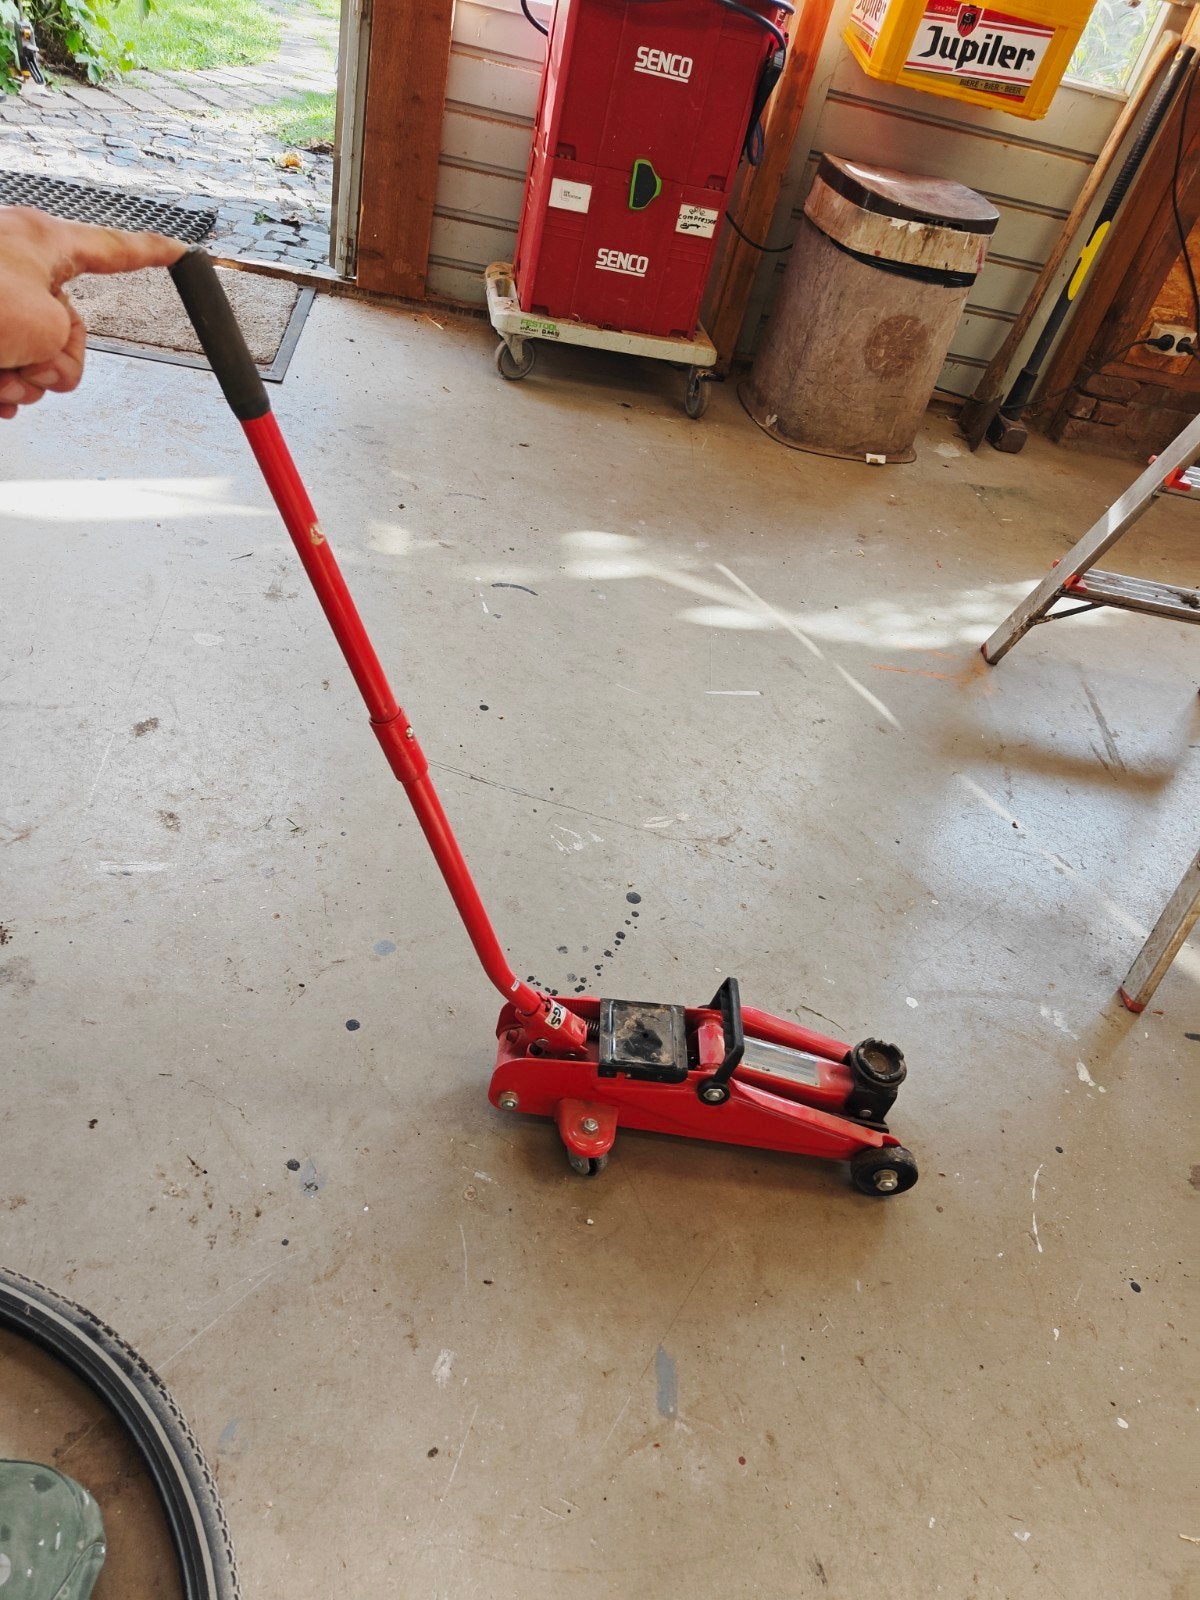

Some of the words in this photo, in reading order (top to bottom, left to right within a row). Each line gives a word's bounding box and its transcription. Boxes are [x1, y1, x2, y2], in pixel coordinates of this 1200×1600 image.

[635, 46, 693, 78] SENCO
[917, 25, 1036, 70] Jupiler
[596, 248, 649, 273] SENCO
